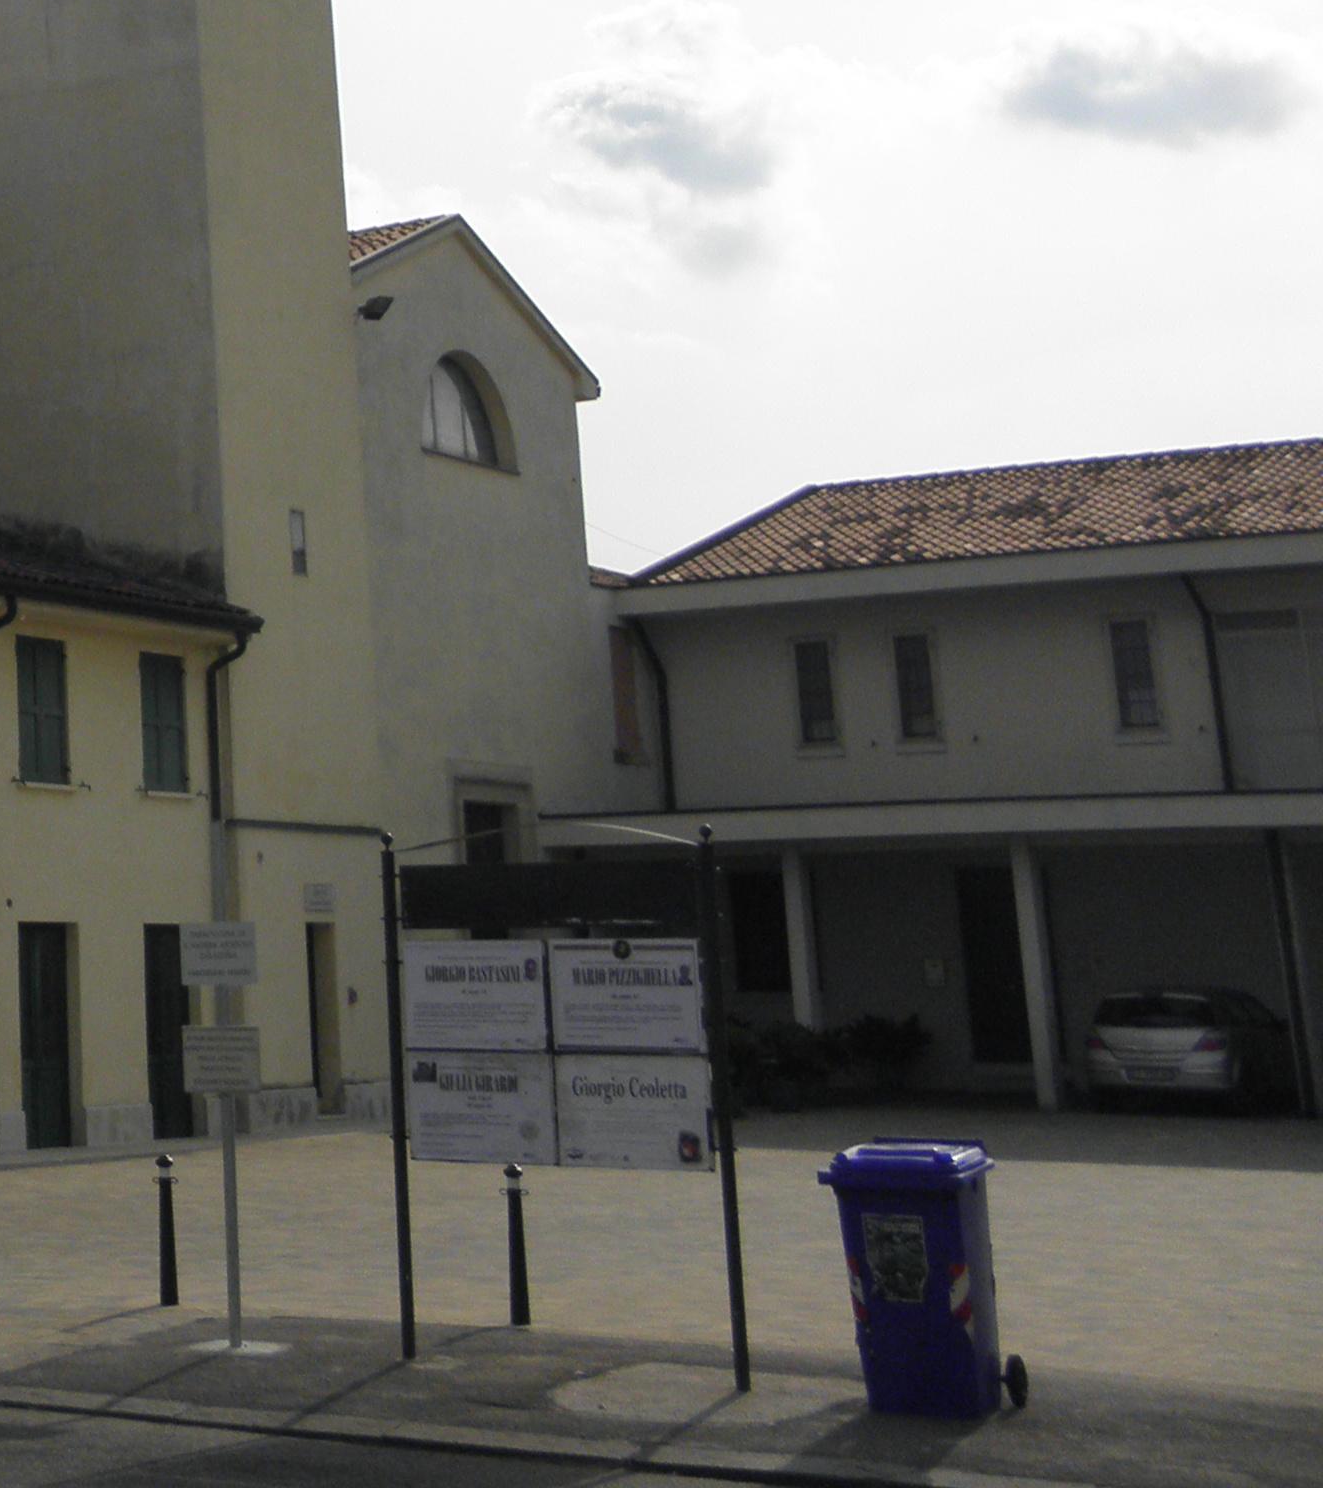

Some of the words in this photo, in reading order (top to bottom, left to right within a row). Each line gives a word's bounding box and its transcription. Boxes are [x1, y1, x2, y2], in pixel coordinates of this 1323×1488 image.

[425, 965, 466, 983] GIORGIO
[468, 964, 521, 983] BASTASINI
[572, 967, 606, 986] MARIO
[608, 967, 680, 987] PIZZIGHELLA
[475, 1074, 519, 1093] GIRARDI
[571, 1075, 625, 1104] Giorgio
[629, 1075, 688, 1099] Ceoletta
